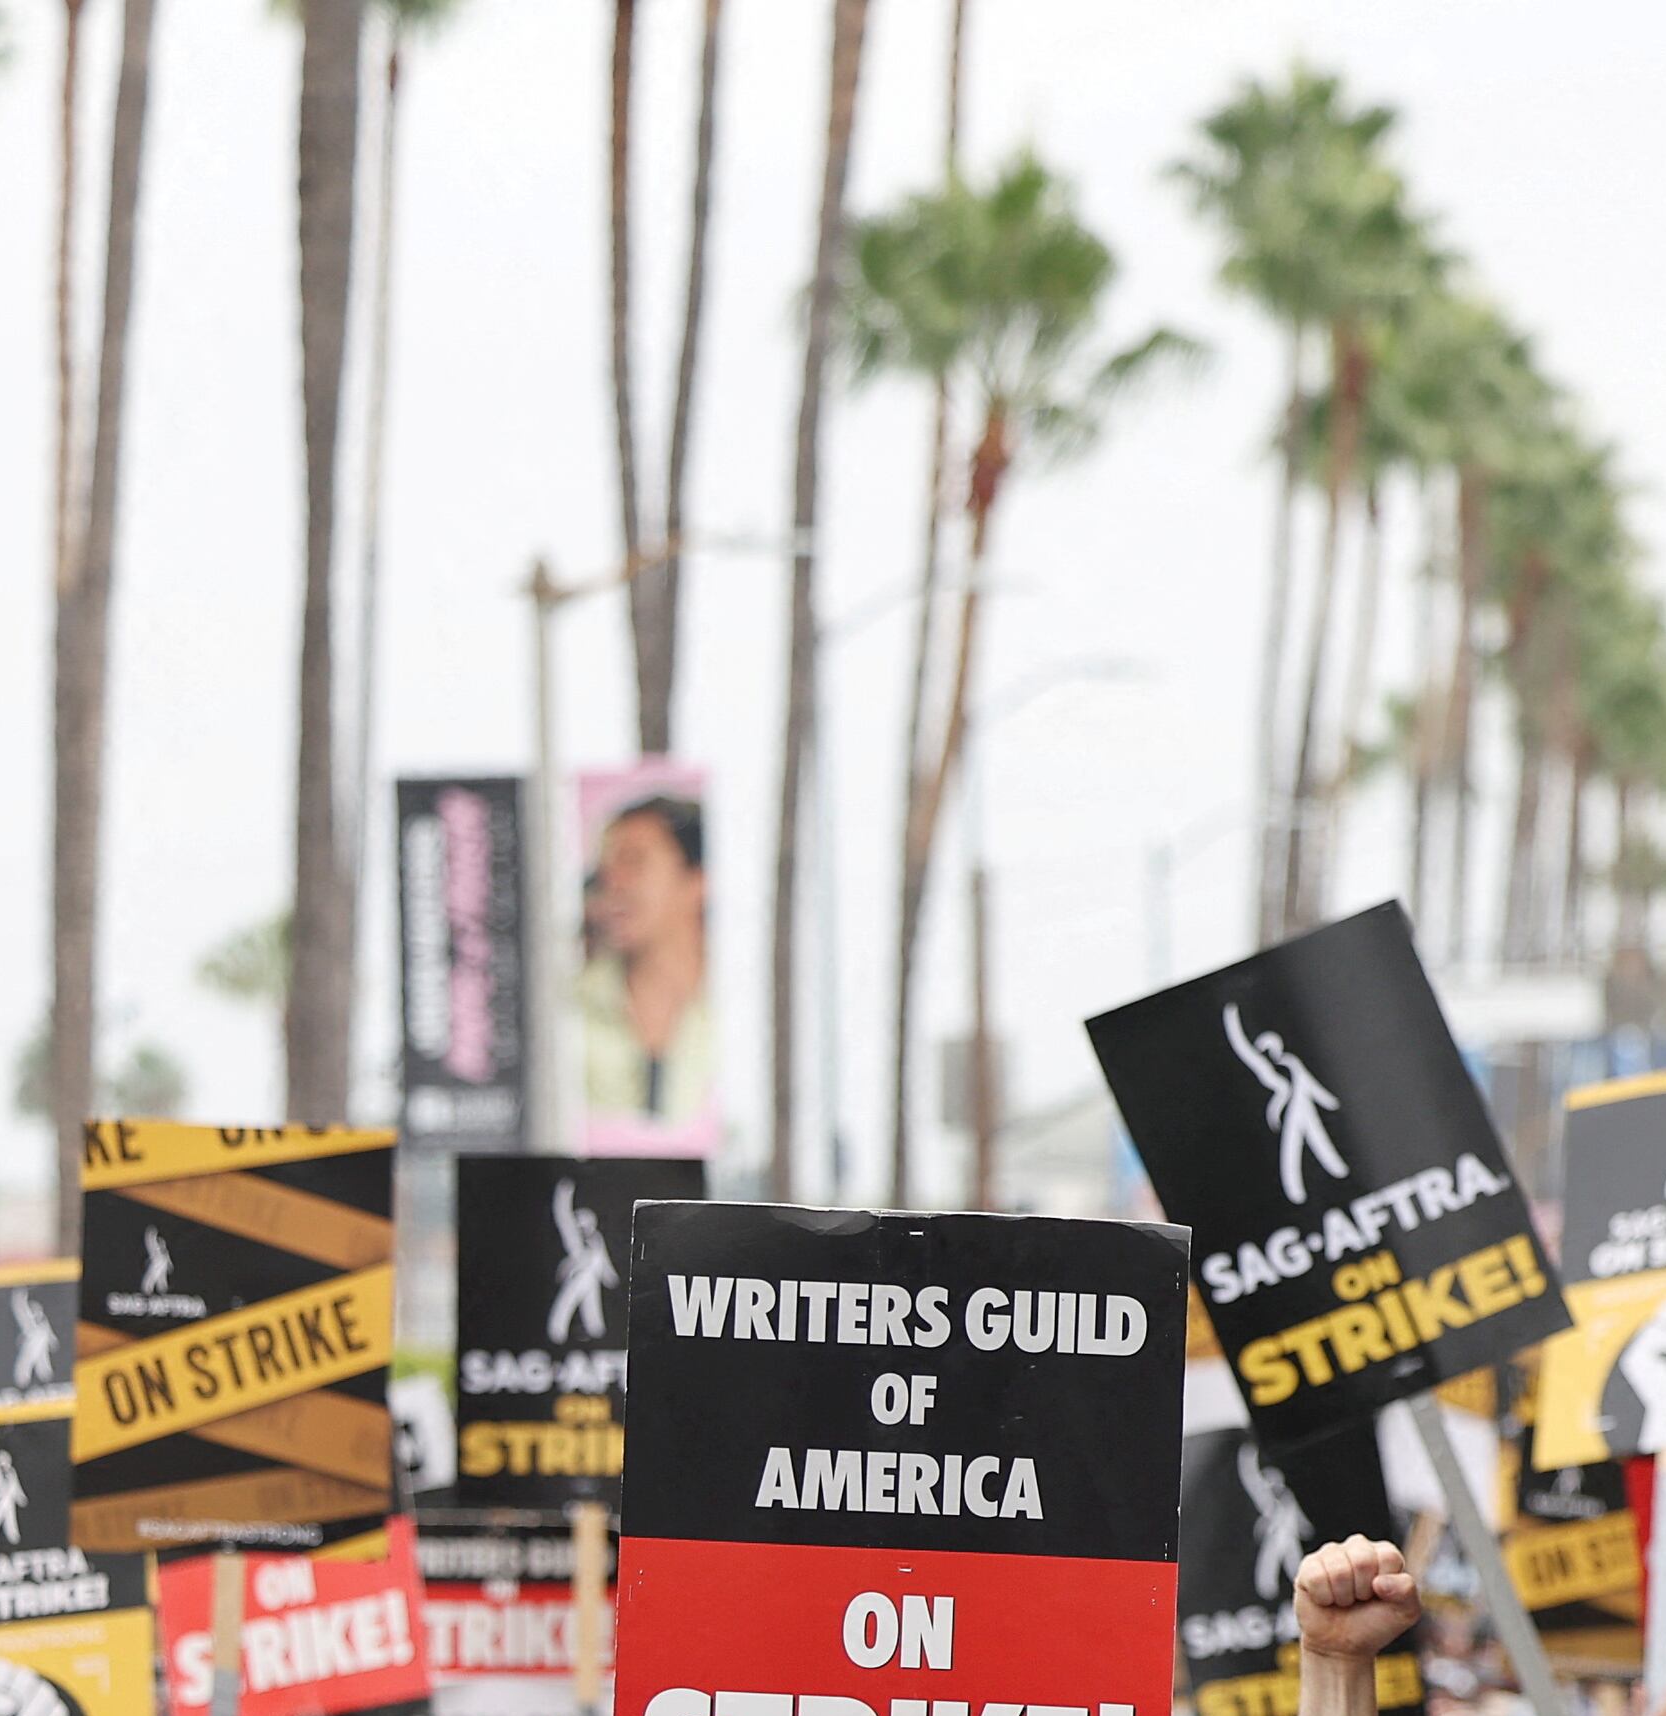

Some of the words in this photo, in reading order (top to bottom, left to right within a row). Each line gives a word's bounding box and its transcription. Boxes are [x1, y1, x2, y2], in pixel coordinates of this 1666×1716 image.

[1332, 1248, 1402, 1301] ON
[667, 1273, 952, 1349] WRITERS
[964, 1286, 1149, 1357] GUILD
[1237, 1232, 1548, 1407] STRIKE!
[101, 1354, 177, 1427] ON
[185, 1291, 369, 1400] STRIKE
[870, 1372, 938, 1426] OF
[458, 1419, 624, 1478] STRI
[754, 1446, 1045, 1521] AMERICA
[253, 1557, 317, 1612] ON
[173, 1587, 416, 1708] SRIKE!
[842, 1590, 955, 1671] ON
